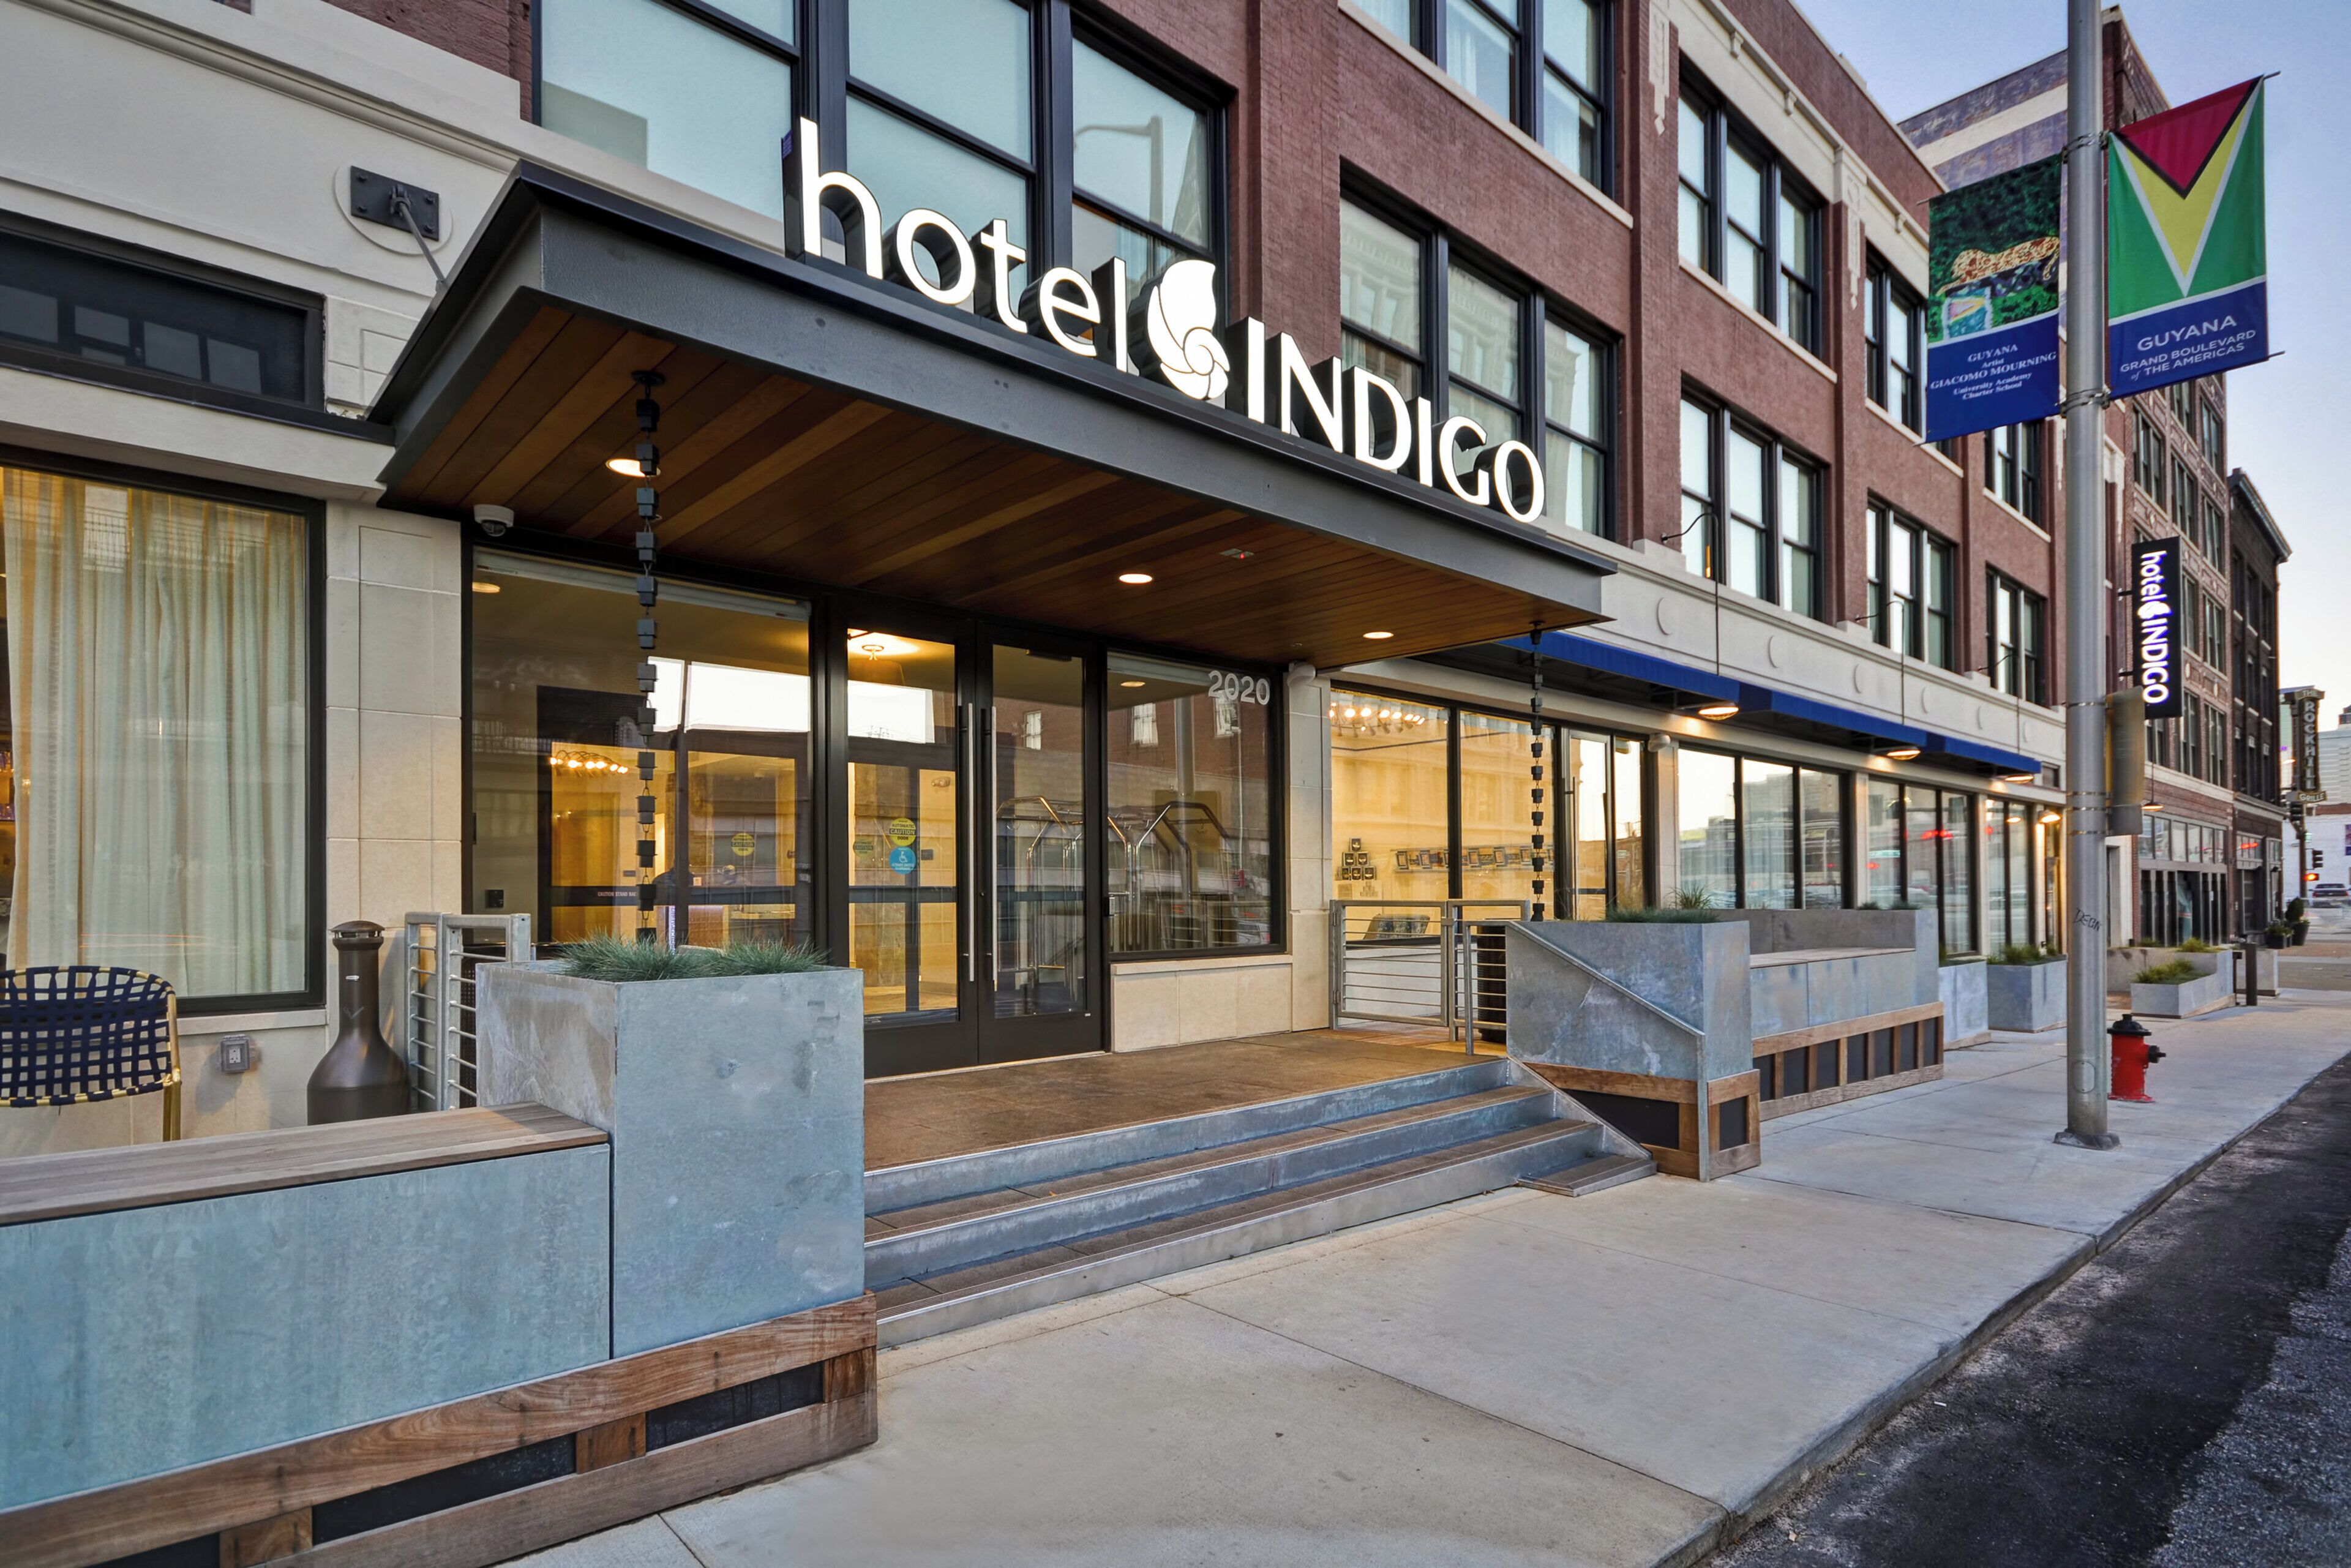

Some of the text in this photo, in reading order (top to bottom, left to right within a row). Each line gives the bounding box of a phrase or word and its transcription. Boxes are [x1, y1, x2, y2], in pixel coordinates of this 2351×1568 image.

[800, 116, 1545, 523] hotel INDIGO
[2137, 315, 2237, 351] GUYANA
[1967, 343, 2018, 362] GUYANA
[1981, 358, 2004, 369] Artist
[2120, 329, 2256, 372] GRAND BOULEVARD
[2131, 342, 2244, 381] of THE AMERICAS
[1930, 351, 2057, 389] GIACOMO MOURNING
[1953, 372, 2033, 395] University Academy
[1962, 381, 2022, 400] Charter School
[2140, 550, 2170, 703] hotel INDIGO
[1208, 670, 1270, 705] 2020
[2304, 700, 2315, 789] ROCKHILL
[2299, 793, 2325, 801] GRILLE
